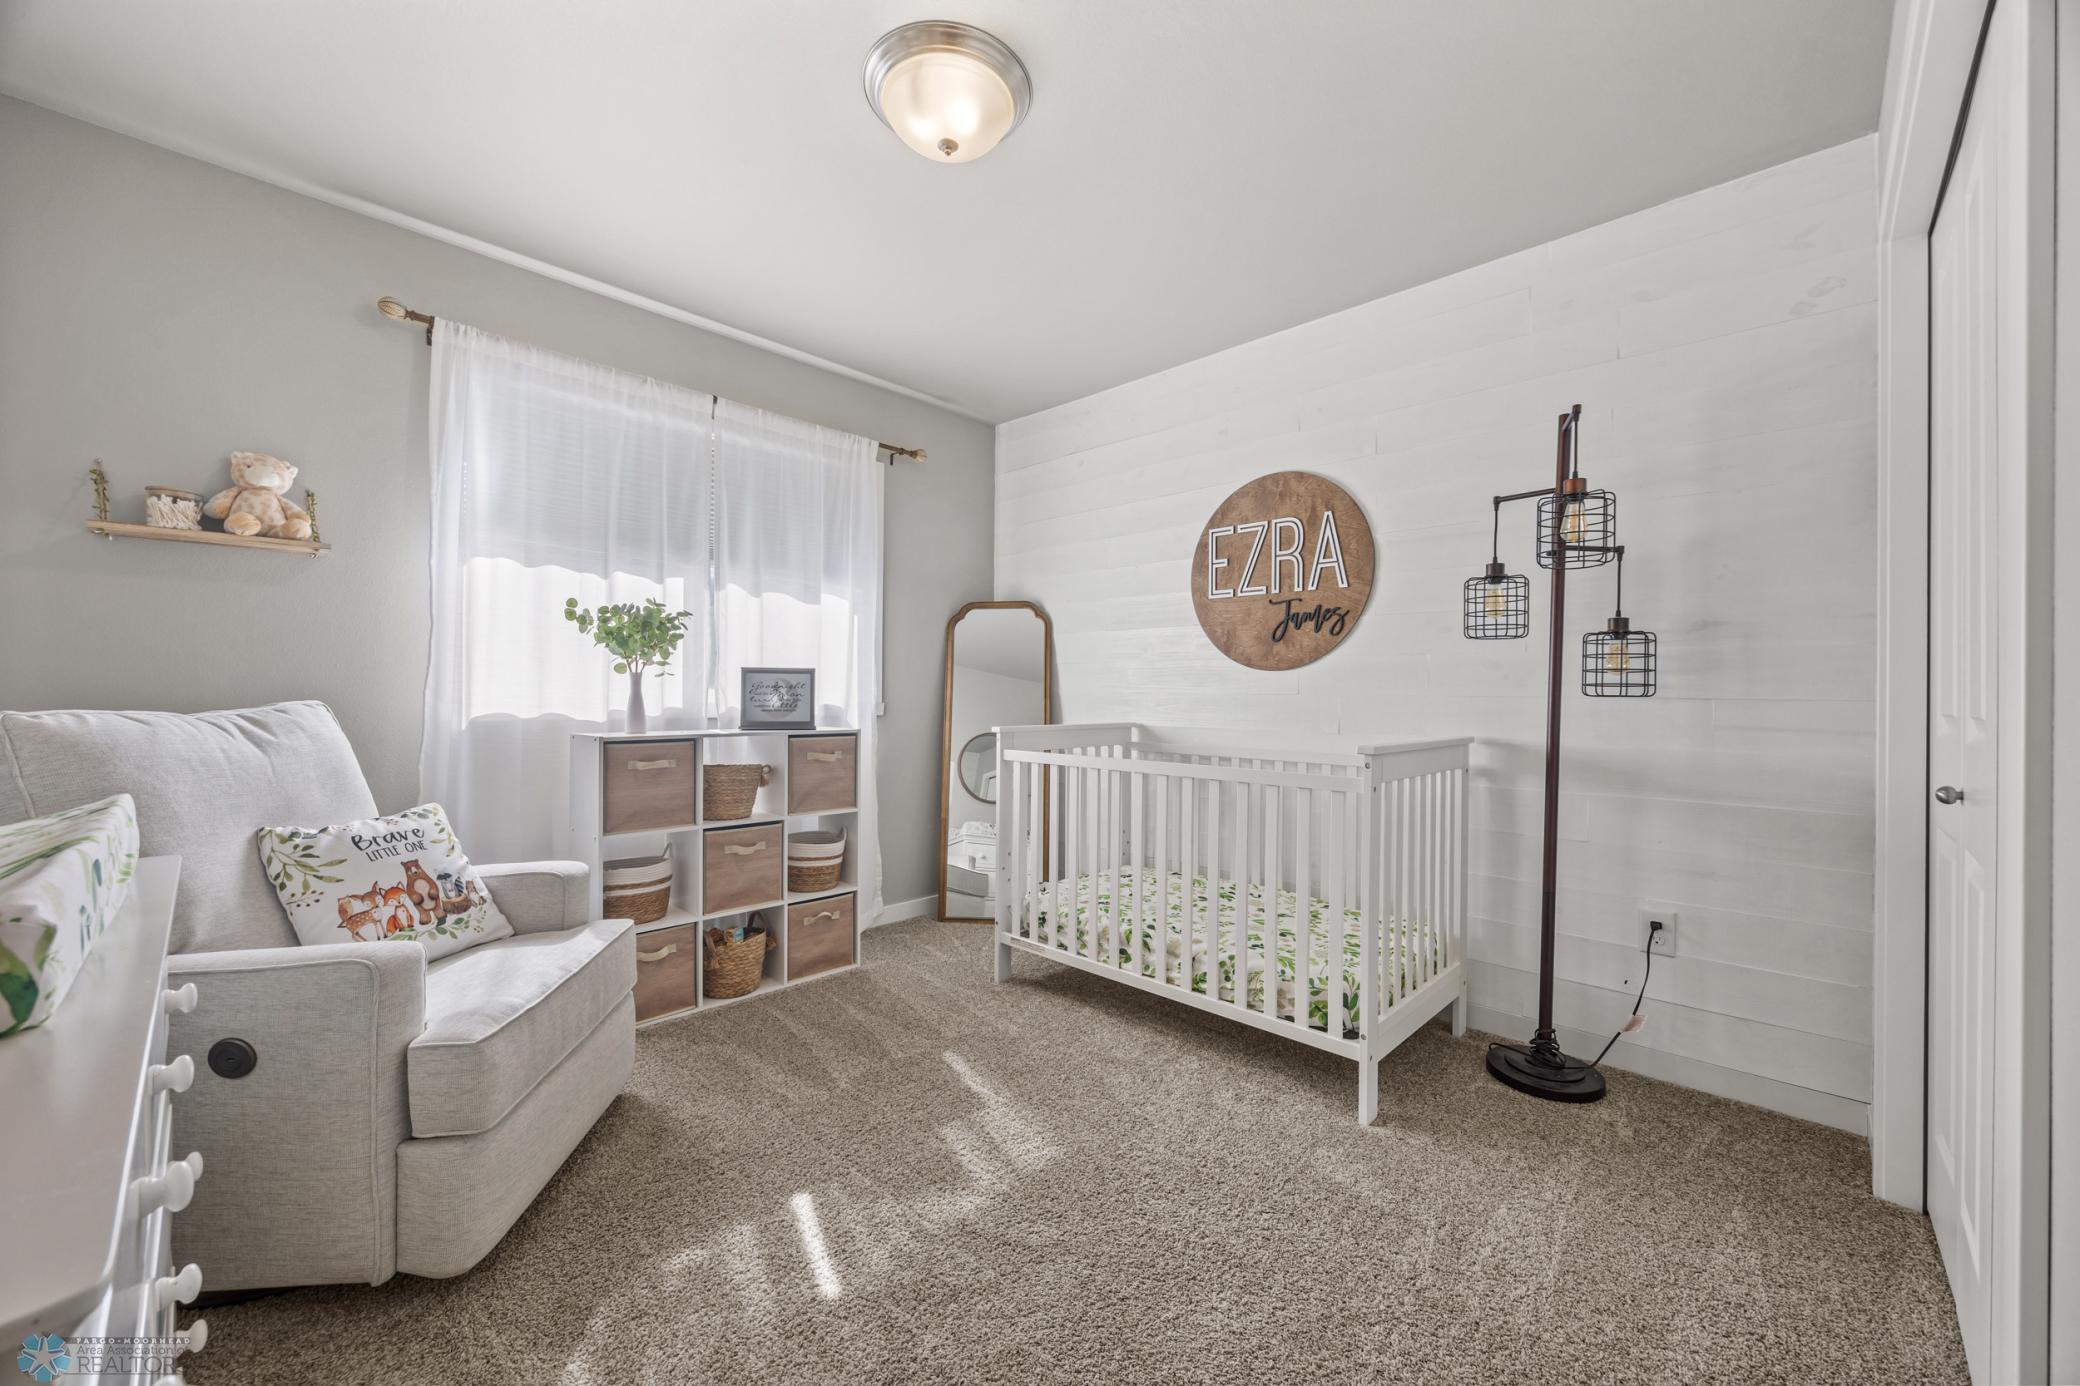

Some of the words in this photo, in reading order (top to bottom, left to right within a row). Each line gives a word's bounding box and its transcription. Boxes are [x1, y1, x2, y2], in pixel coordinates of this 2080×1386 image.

[1208, 511, 1349, 600] EZRA
[1268, 598, 1350, 643] James
[351, 828, 425, 852] Brave
[365, 845, 402, 862] LITTLE
[404, 840, 428, 853] ONE
